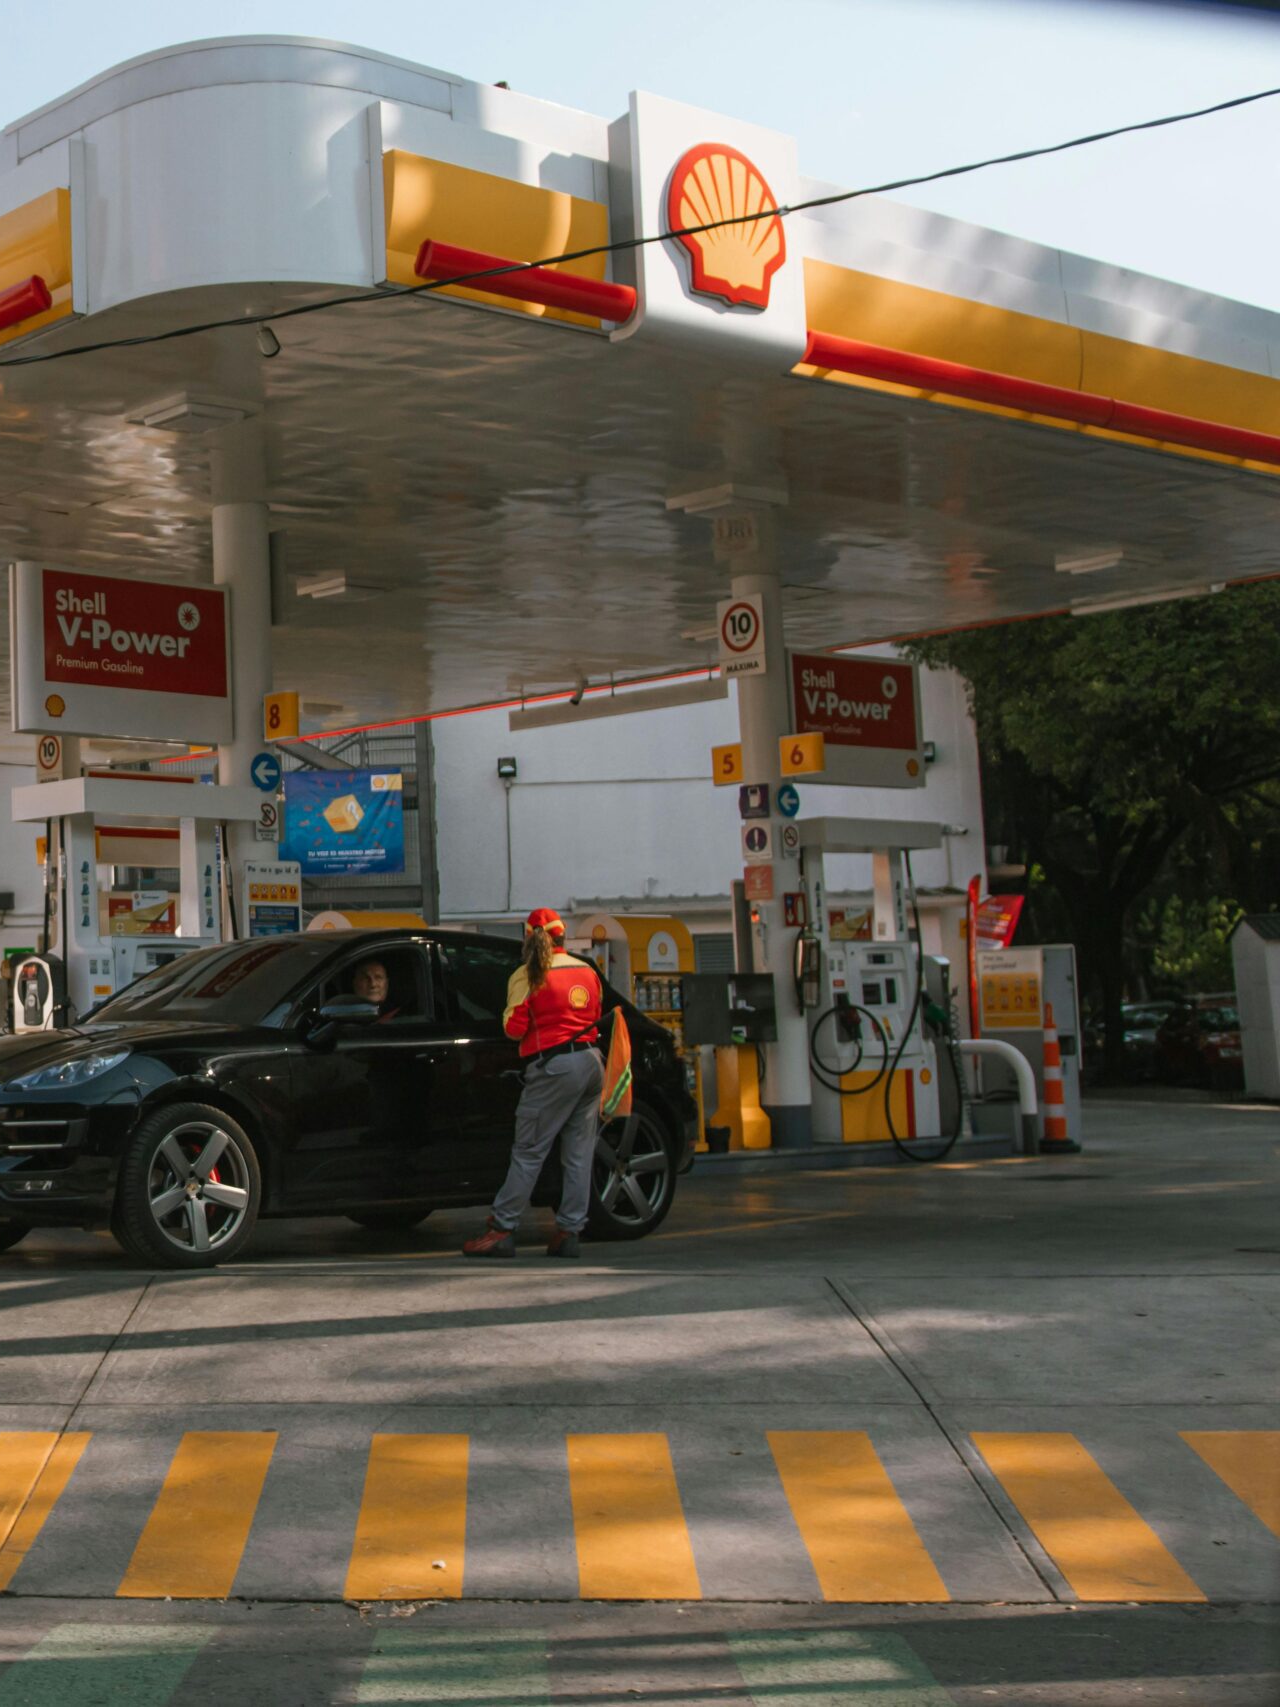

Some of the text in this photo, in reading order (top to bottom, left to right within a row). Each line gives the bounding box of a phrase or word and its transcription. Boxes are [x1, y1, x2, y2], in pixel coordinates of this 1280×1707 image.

[55, 589, 106, 616] Shell
[729, 612, 752, 636] 10
[56, 615, 191, 658] V-Power
[55, 653, 144, 675] Premium Gasoline
[801, 669, 835, 689] Shell
[269, 703, 280, 729] 8
[802, 690, 892, 720] V-Power
[42, 741, 56, 758] 10
[790, 744, 804, 766] 6
[722, 753, 735, 775] 5
